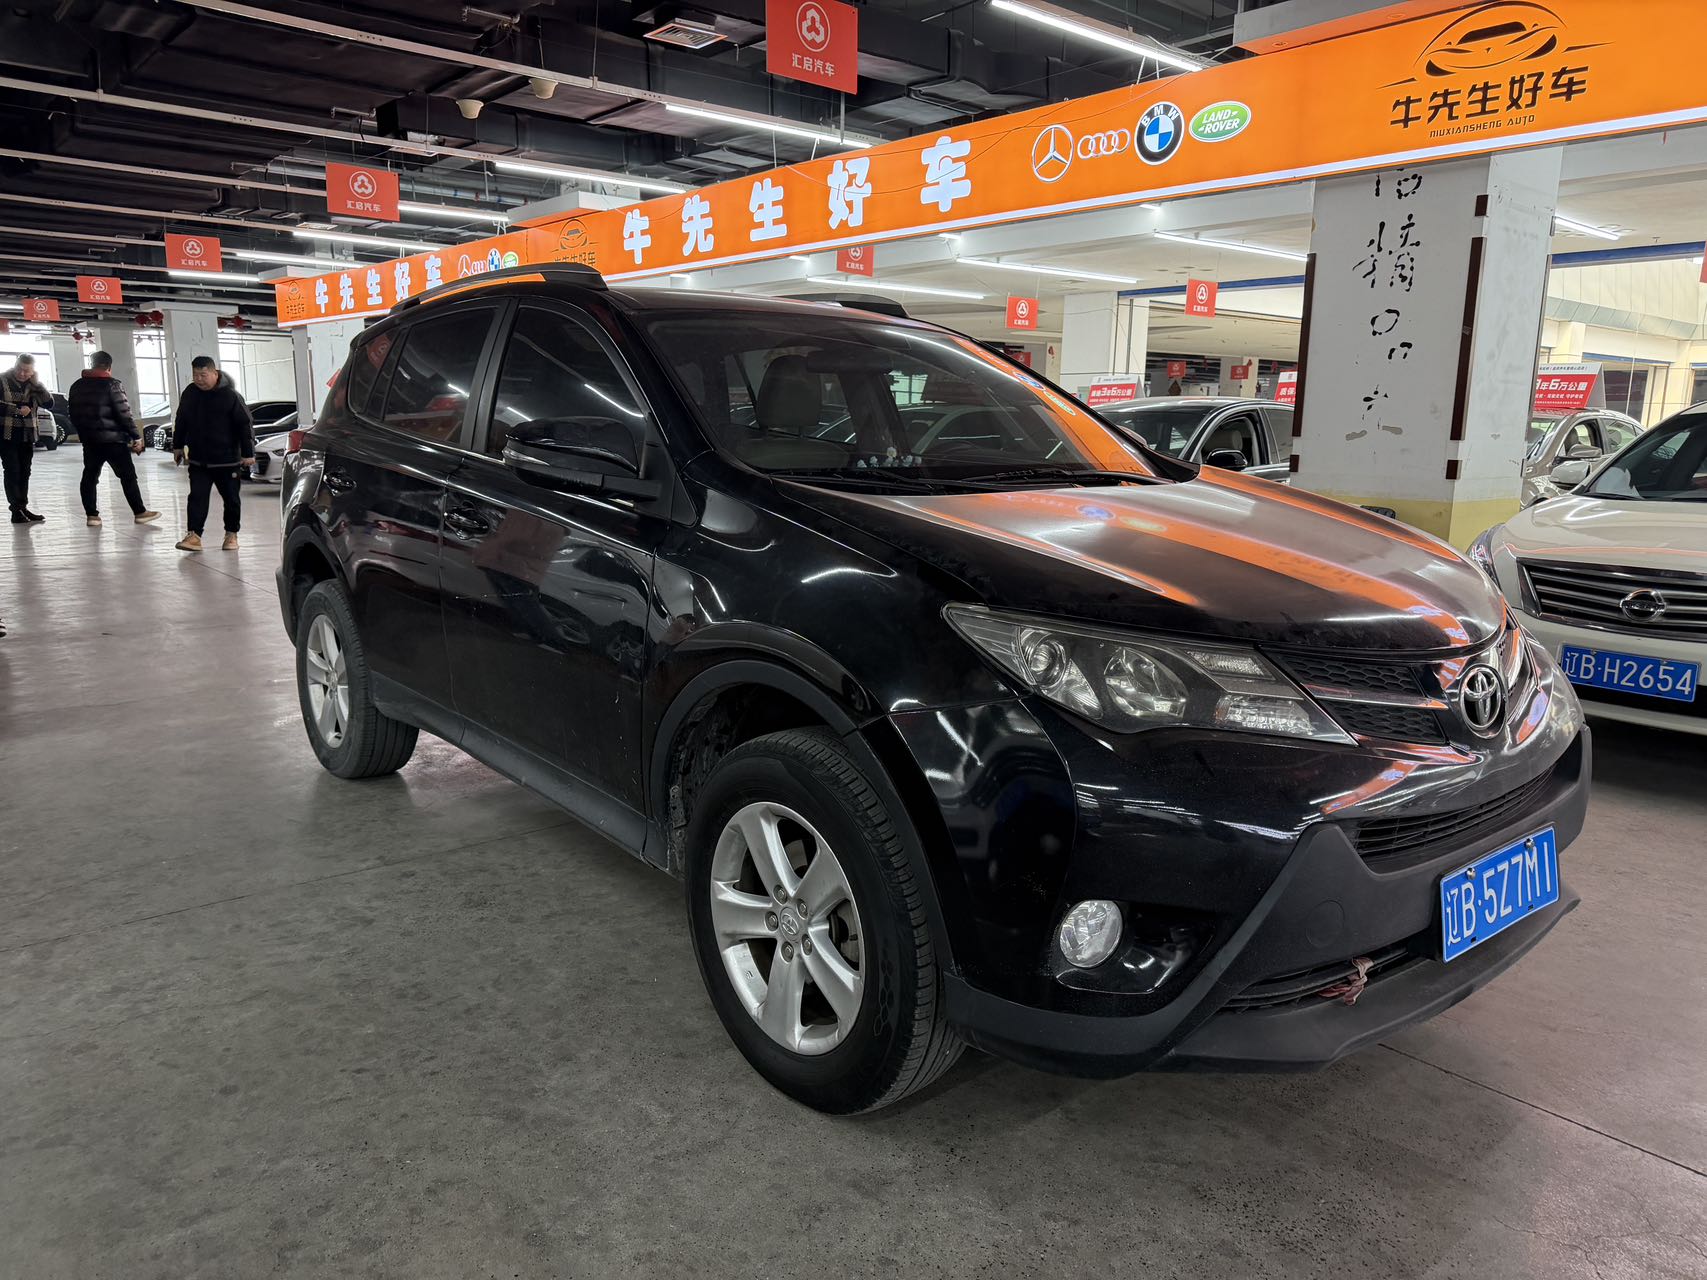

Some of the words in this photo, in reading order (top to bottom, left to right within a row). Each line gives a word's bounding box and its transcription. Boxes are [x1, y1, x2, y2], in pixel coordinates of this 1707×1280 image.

[792, 53, 835, 77] 汇启汽车
[1390, 66, 1589, 128] 牛先生好车
[1142, 105, 1179, 127] BMW
[1202, 109, 1231, 124] LAND
[1205, 119, 1240, 134] ROVER
[1507, 115, 1536, 127] AUTO
[623, 136, 971, 264] 牛先生好车
[315, 255, 443, 314] 牛先生好车
[1565, 651, 1692, 695] 辽B·H2654
